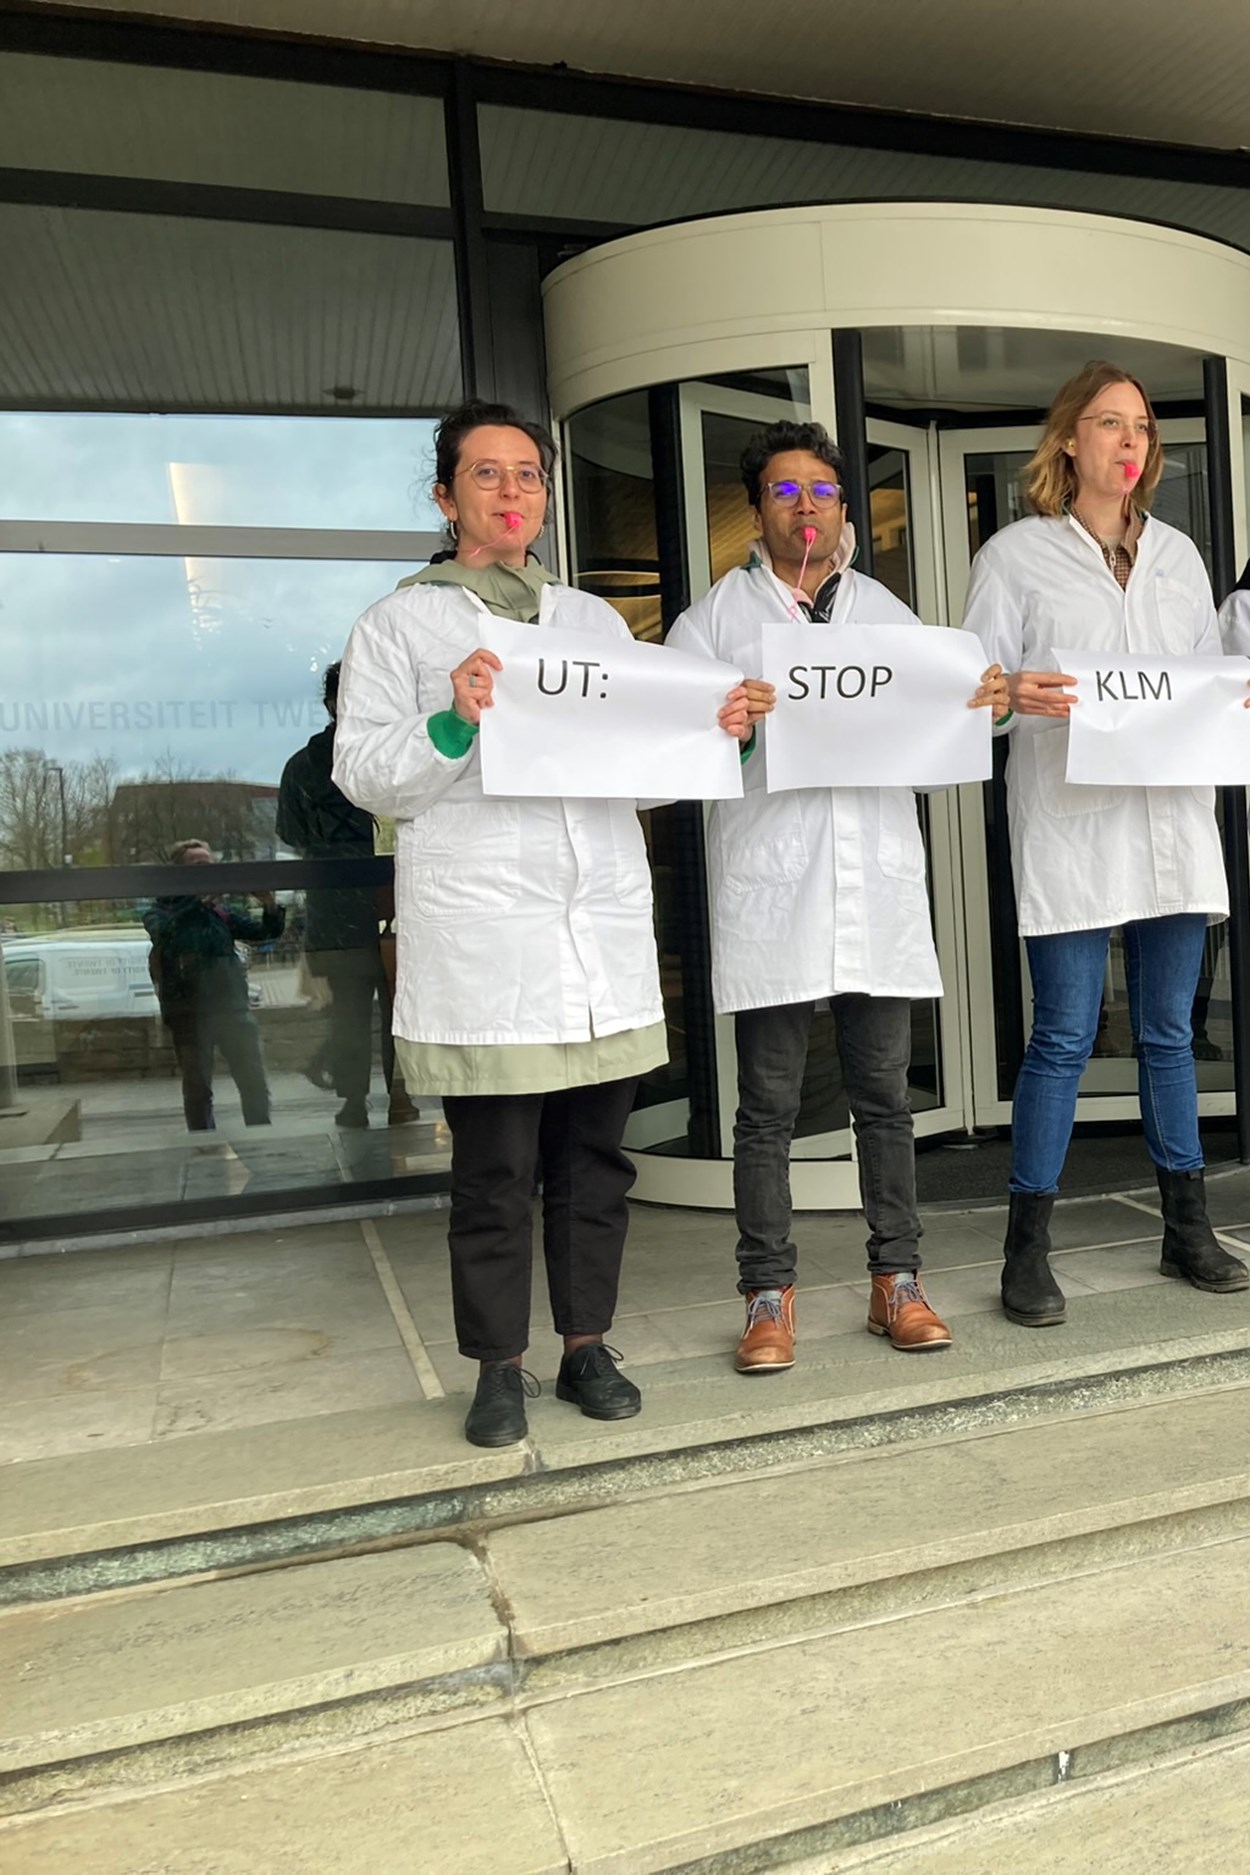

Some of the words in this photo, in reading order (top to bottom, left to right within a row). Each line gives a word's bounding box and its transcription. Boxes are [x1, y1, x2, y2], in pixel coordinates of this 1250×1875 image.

[537, 657, 608, 699] UT:
[787, 665, 893, 700] STOP
[1095, 670, 1173, 701] KLM
[0, 699, 238, 732] UNIVERSITEIT
